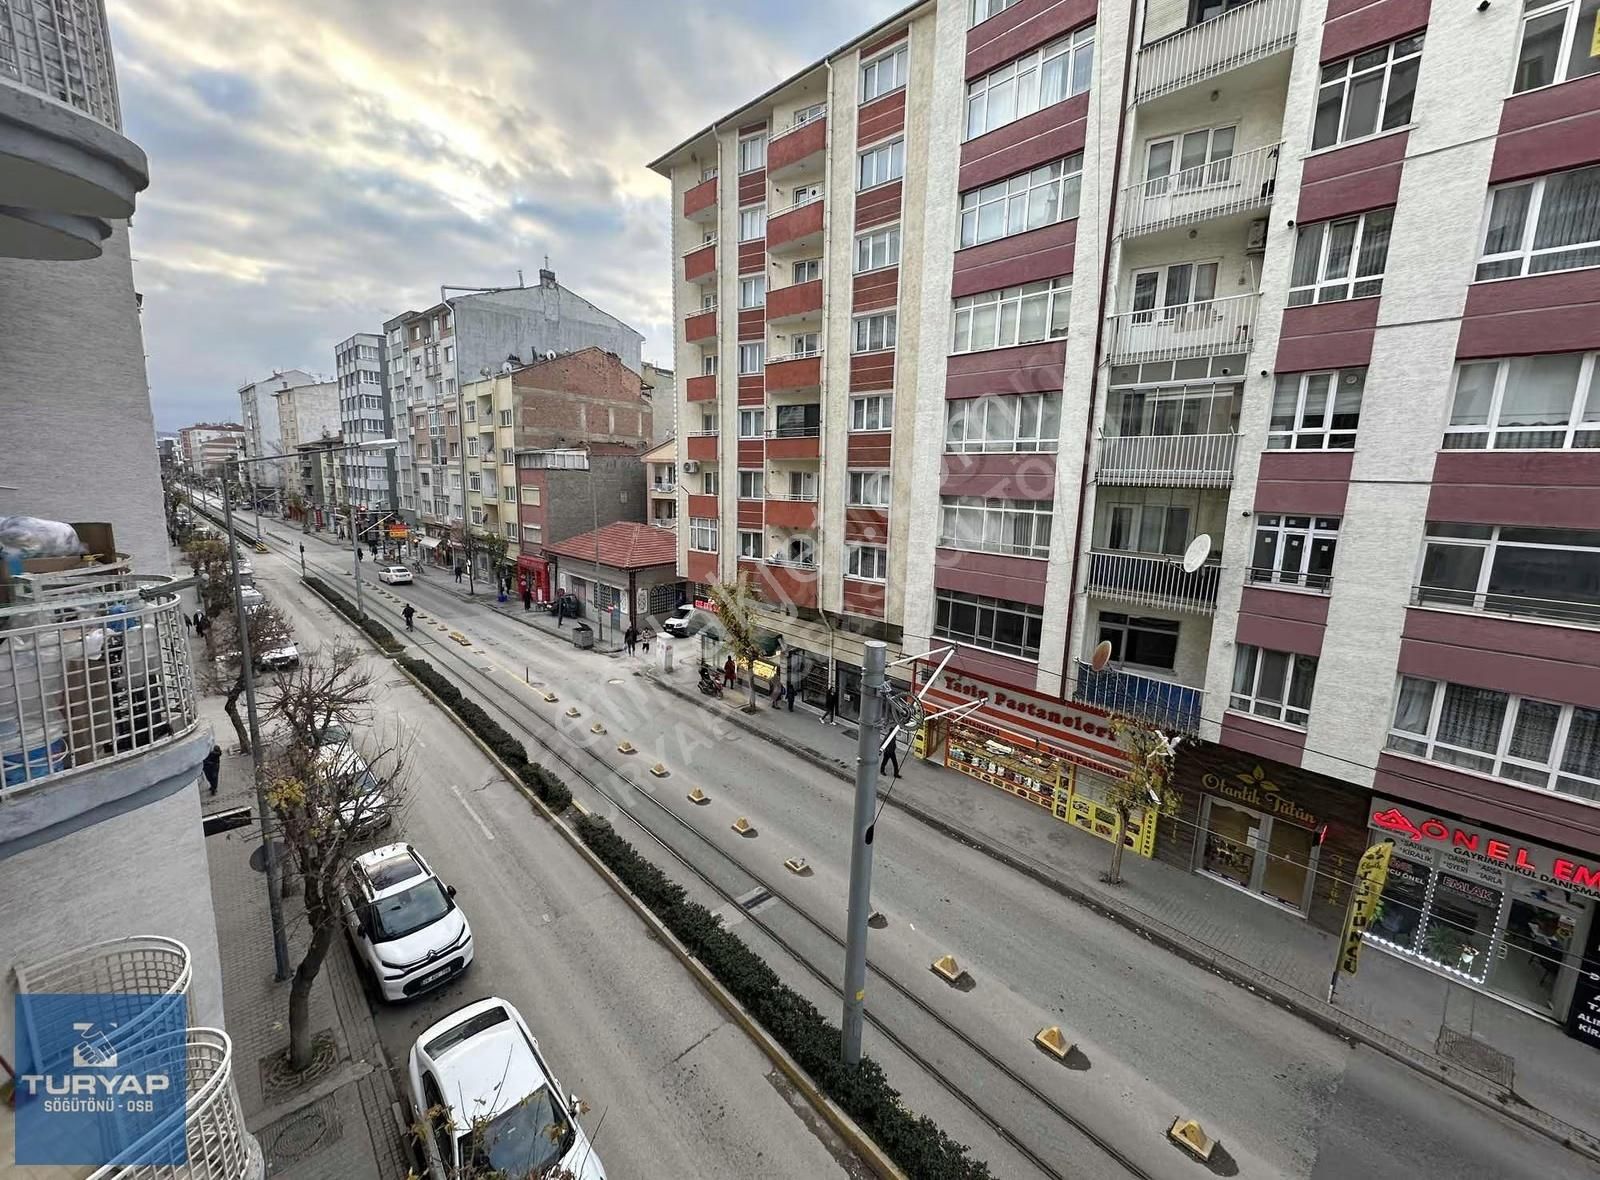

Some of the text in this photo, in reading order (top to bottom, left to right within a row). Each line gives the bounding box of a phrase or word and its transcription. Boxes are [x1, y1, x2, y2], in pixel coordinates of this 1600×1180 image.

[944, 676, 1117, 742] Yasin Pastaneleri
[1202, 773, 1317, 823] Otantik Tütün
[1420, 819, 1536, 870] ÖNEL
[1442, 876, 1495, 902] EMLAK
